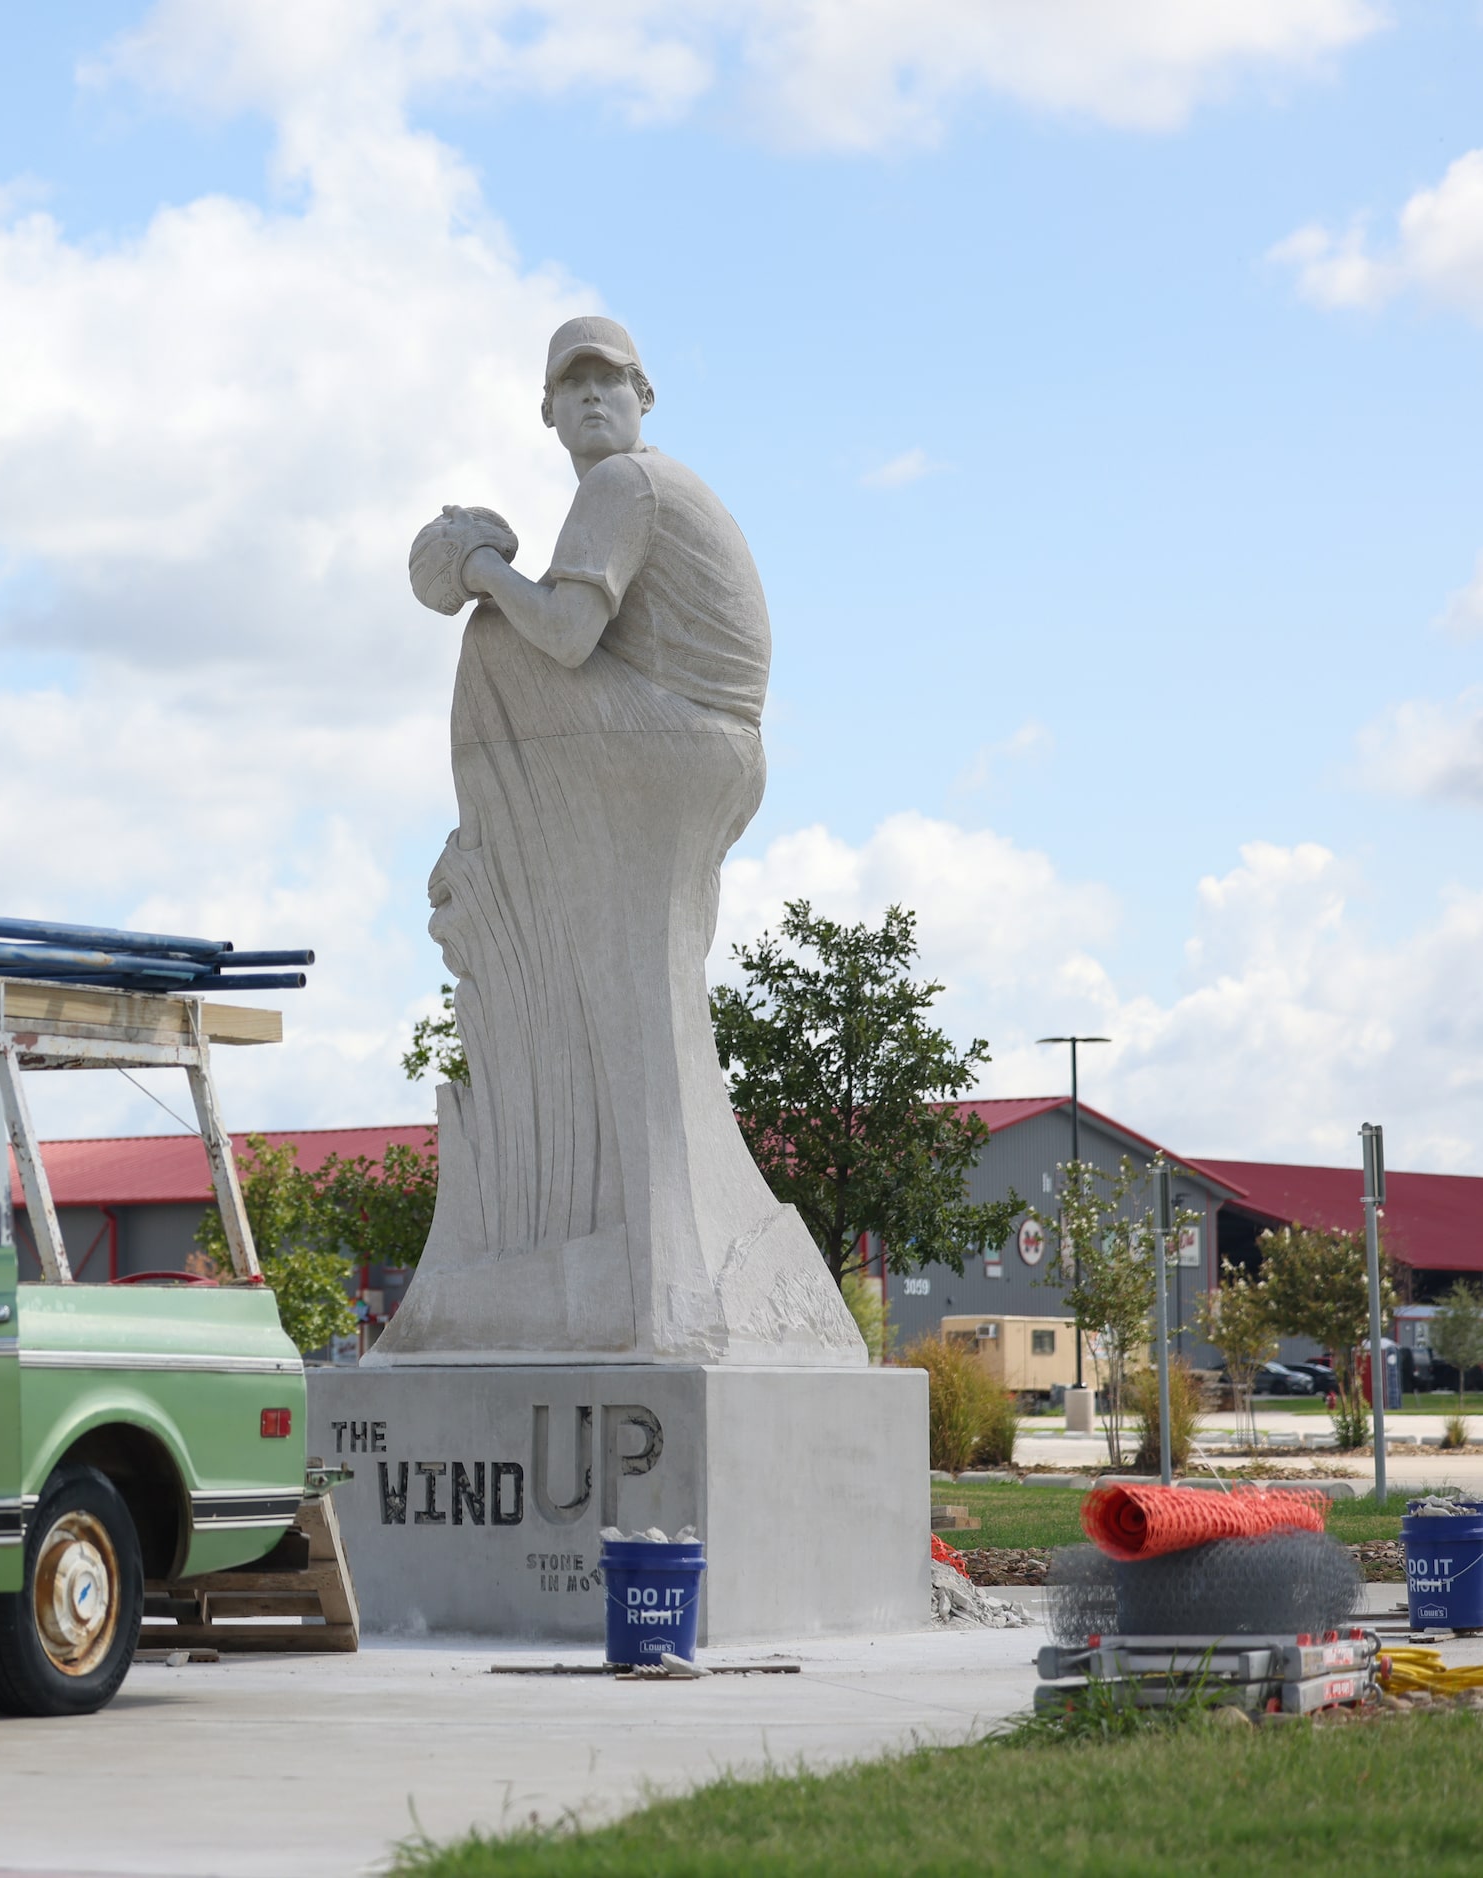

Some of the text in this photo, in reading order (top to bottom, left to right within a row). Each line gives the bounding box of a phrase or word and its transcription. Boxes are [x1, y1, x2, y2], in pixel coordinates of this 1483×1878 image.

[331, 1421, 387, 1453] THE
[377, 1404, 664, 1528] WIND UP
[526, 1553, 584, 1571] STONE
[1407, 1559, 1453, 1575] DO IT
[540, 1574, 559, 1592] IN
[1410, 1578, 1454, 1592] RIGHT
[627, 1587, 658, 1606] DO
[665, 1588, 684, 1606] IT
[627, 1608, 684, 1626] RIGHT
